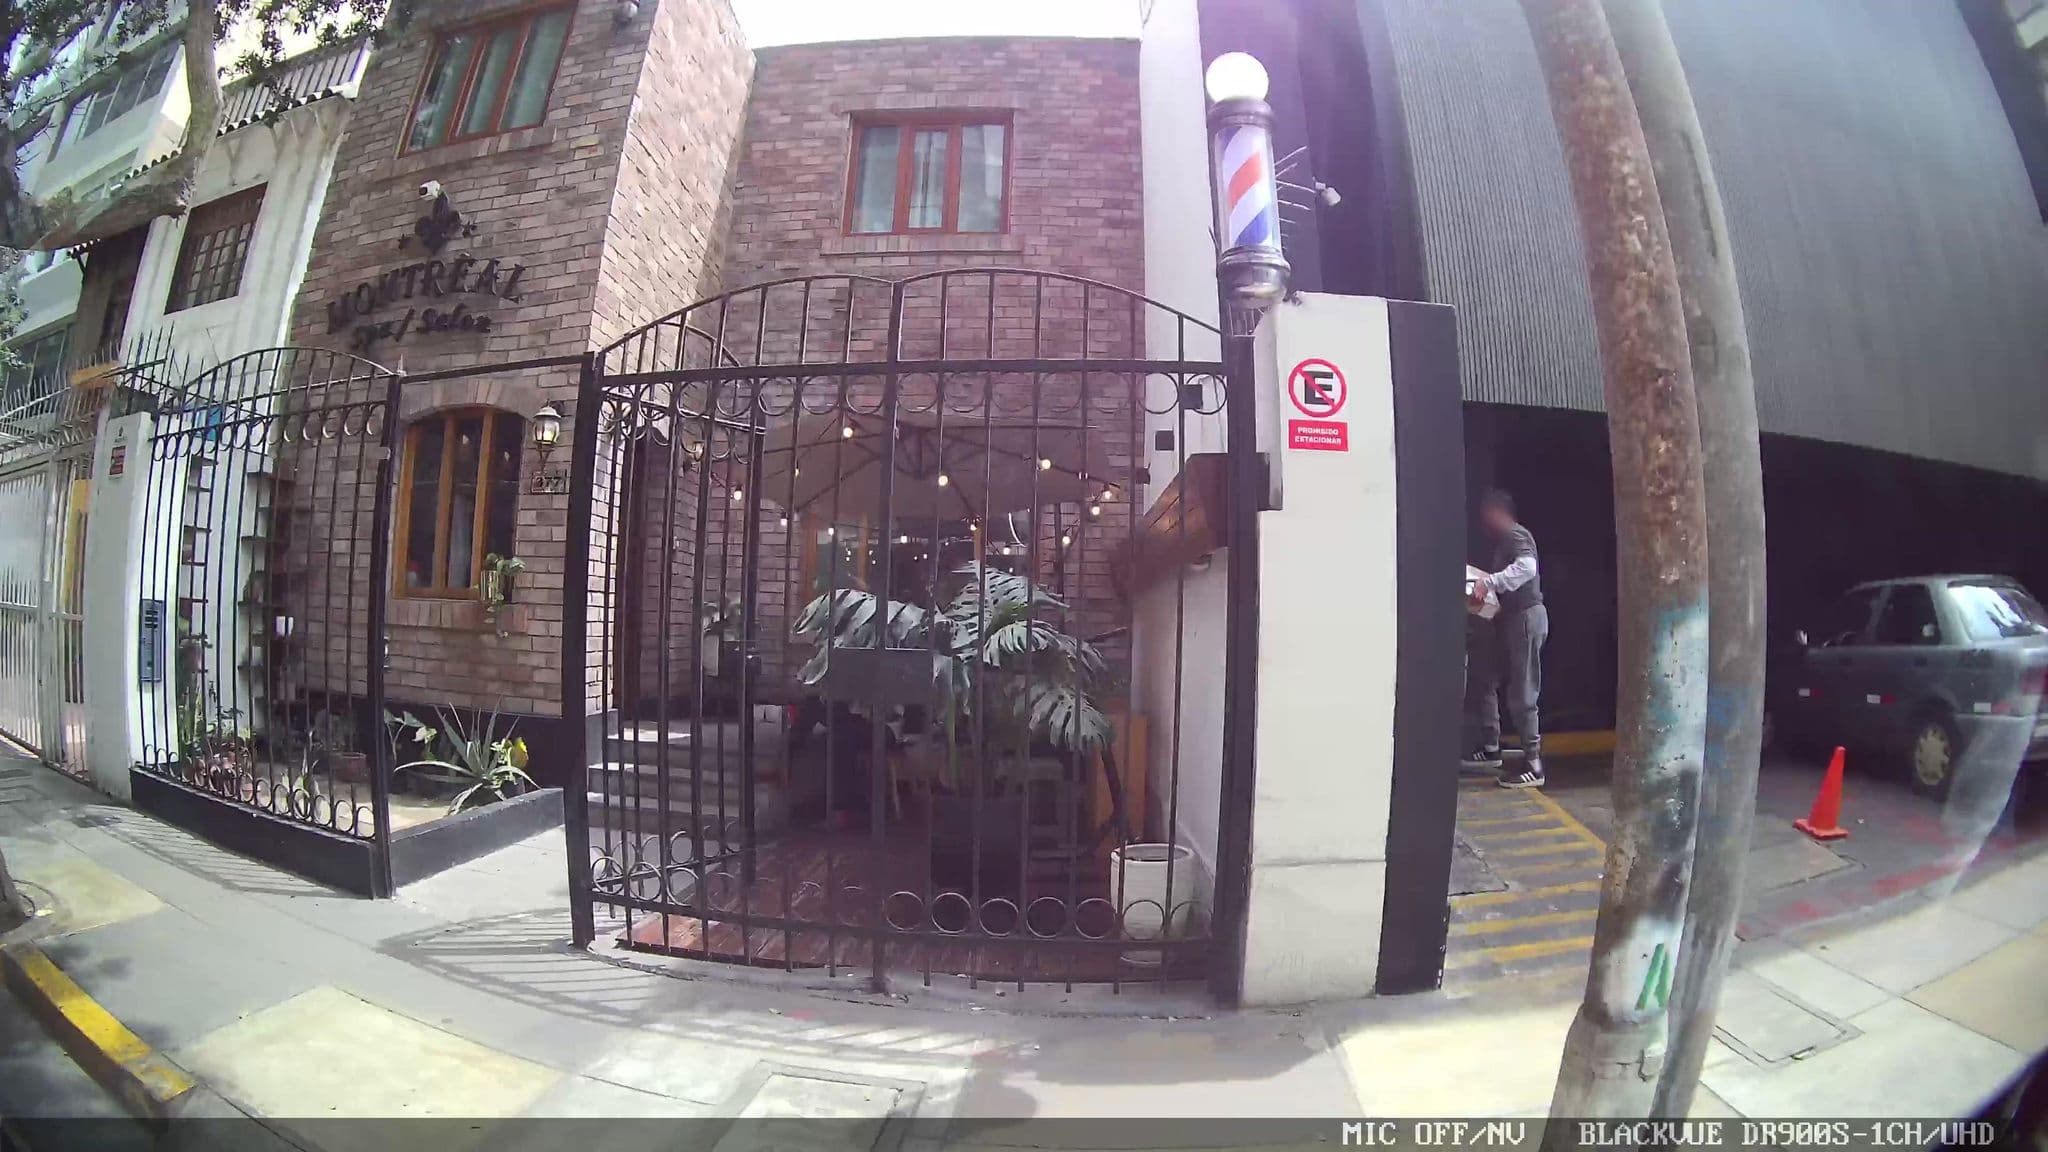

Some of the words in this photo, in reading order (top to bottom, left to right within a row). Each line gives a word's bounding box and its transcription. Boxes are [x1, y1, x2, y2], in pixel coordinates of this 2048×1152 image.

[1304, 371, 1334, 405] E
[1297, 426, 1339, 436] PROHIBIDO
[1294, 435, 1342, 445] ESTACIONAR
